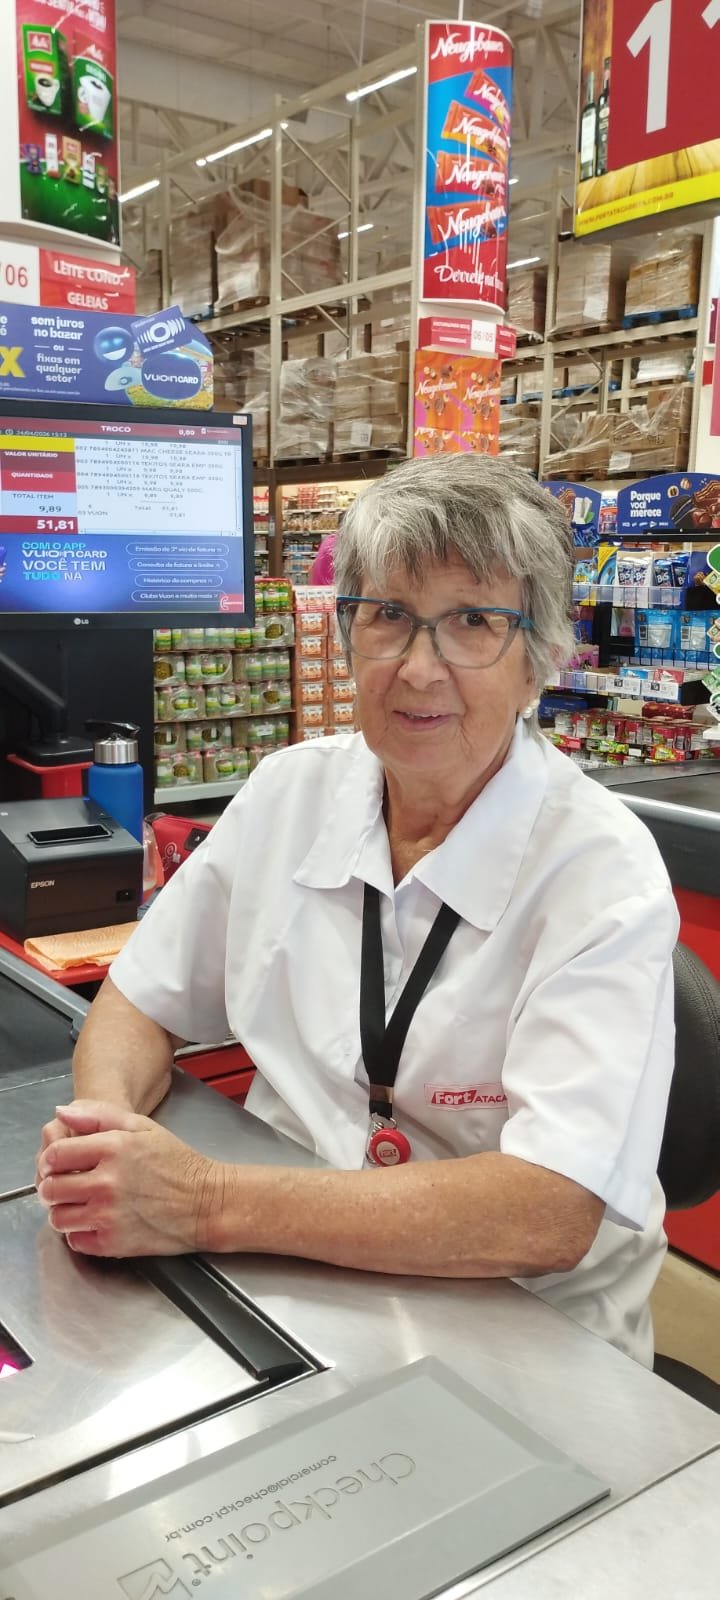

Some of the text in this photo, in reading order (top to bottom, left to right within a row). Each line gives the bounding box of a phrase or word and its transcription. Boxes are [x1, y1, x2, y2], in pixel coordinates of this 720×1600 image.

[66, 291, 108, 310] GELEIAS
[30, 316, 84, 330] sem juros
[34, 326, 82, 340] no bazar
[36, 352, 62, 364] fixas
[36, 364, 82, 376] qualquer
[100, 425, 132, 433] TROCO
[630, 490, 662, 503] Porque
[630, 509, 662, 518] merece
[36, 520, 74, 531] 51,81
[22, 558, 106, 571] VOCÊ TEM
[23, 572, 82, 580] TUDO NA
[31, 880, 55, 889] EPSON
[435, 1092, 472, 1105] Fort
